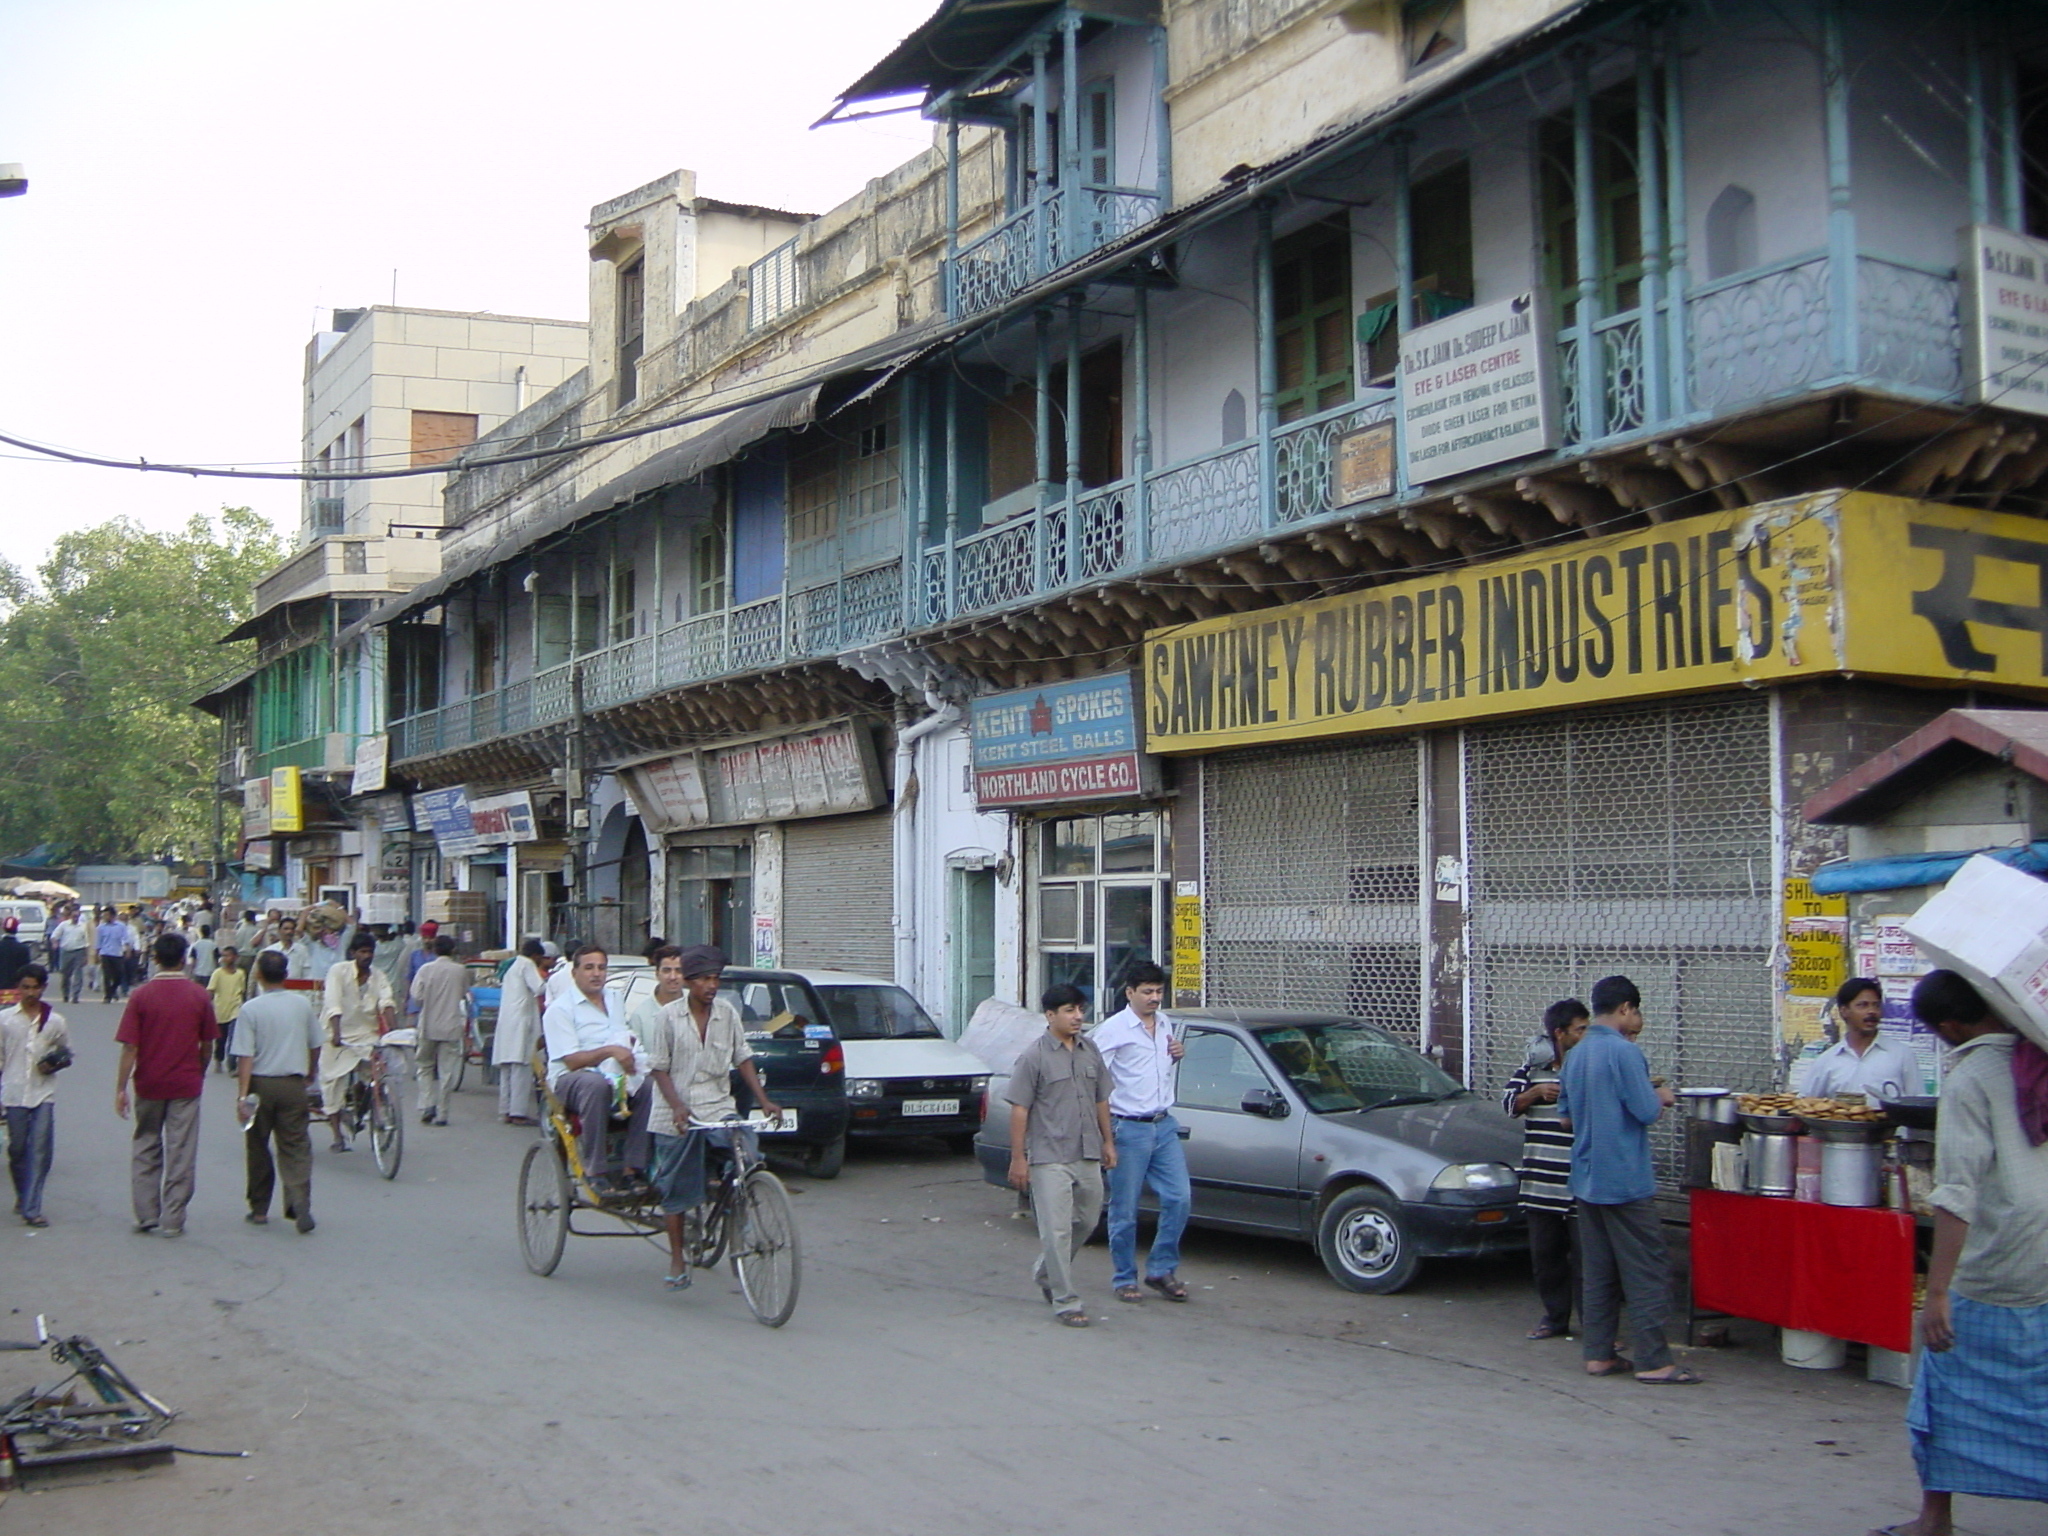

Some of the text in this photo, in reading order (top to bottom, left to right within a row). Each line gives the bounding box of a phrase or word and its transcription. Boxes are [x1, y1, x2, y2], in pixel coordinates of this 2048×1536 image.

[1414, 348, 1521, 396] EYE & LASER CENTRE
[1444, 416, 1465, 431] GREEN
[1467, 407, 1490, 425] LASER
[1493, 401, 1508, 417] FOR
[1511, 394, 1537, 412] RETINA
[1152, 524, 1773, 737] SAWHNEY RUBBER INDUSTRIES
[976, 687, 1124, 739] KENT SPOKES
[978, 729, 1124, 762] KENT STEEL BALLS
[980, 762, 1133, 799] NORTHLAND CYCLE CO.
[1183, 918, 1192, 931] TO
[1802, 901, 1822, 916] TO
[1876, 926, 1884, 939] 2
